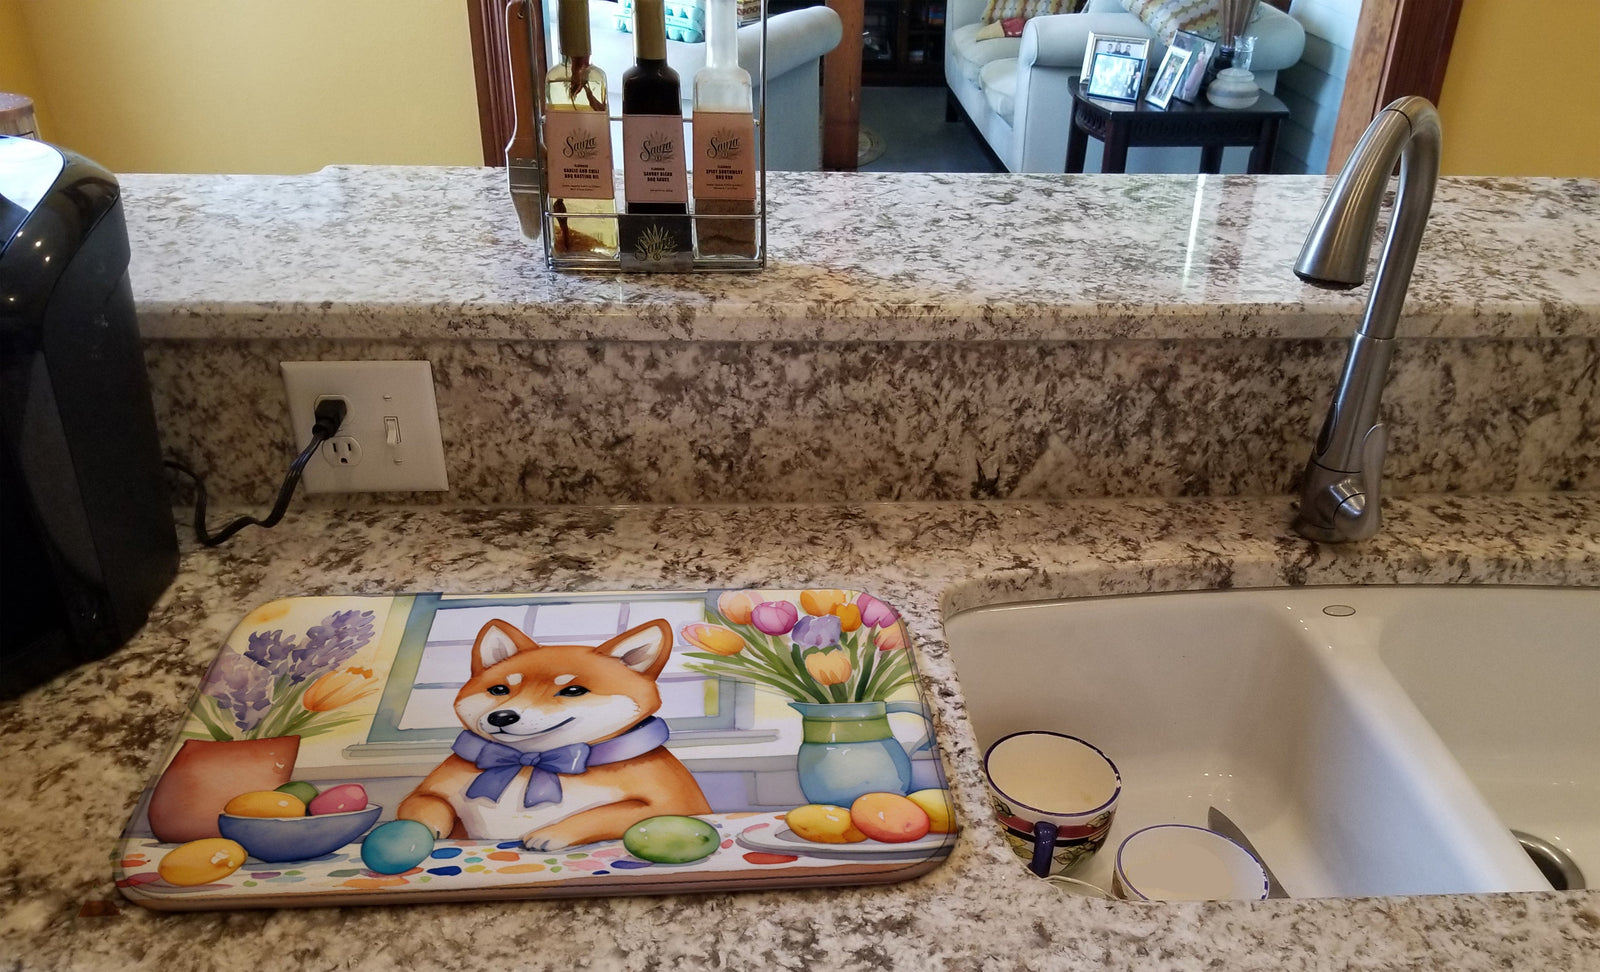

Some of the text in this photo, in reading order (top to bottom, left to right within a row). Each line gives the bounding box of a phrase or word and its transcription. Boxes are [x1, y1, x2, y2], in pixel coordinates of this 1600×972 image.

[562, 136, 597, 158] Sauza
[640, 140, 674, 162] Sauza
[706, 136, 740, 159] Sauza
